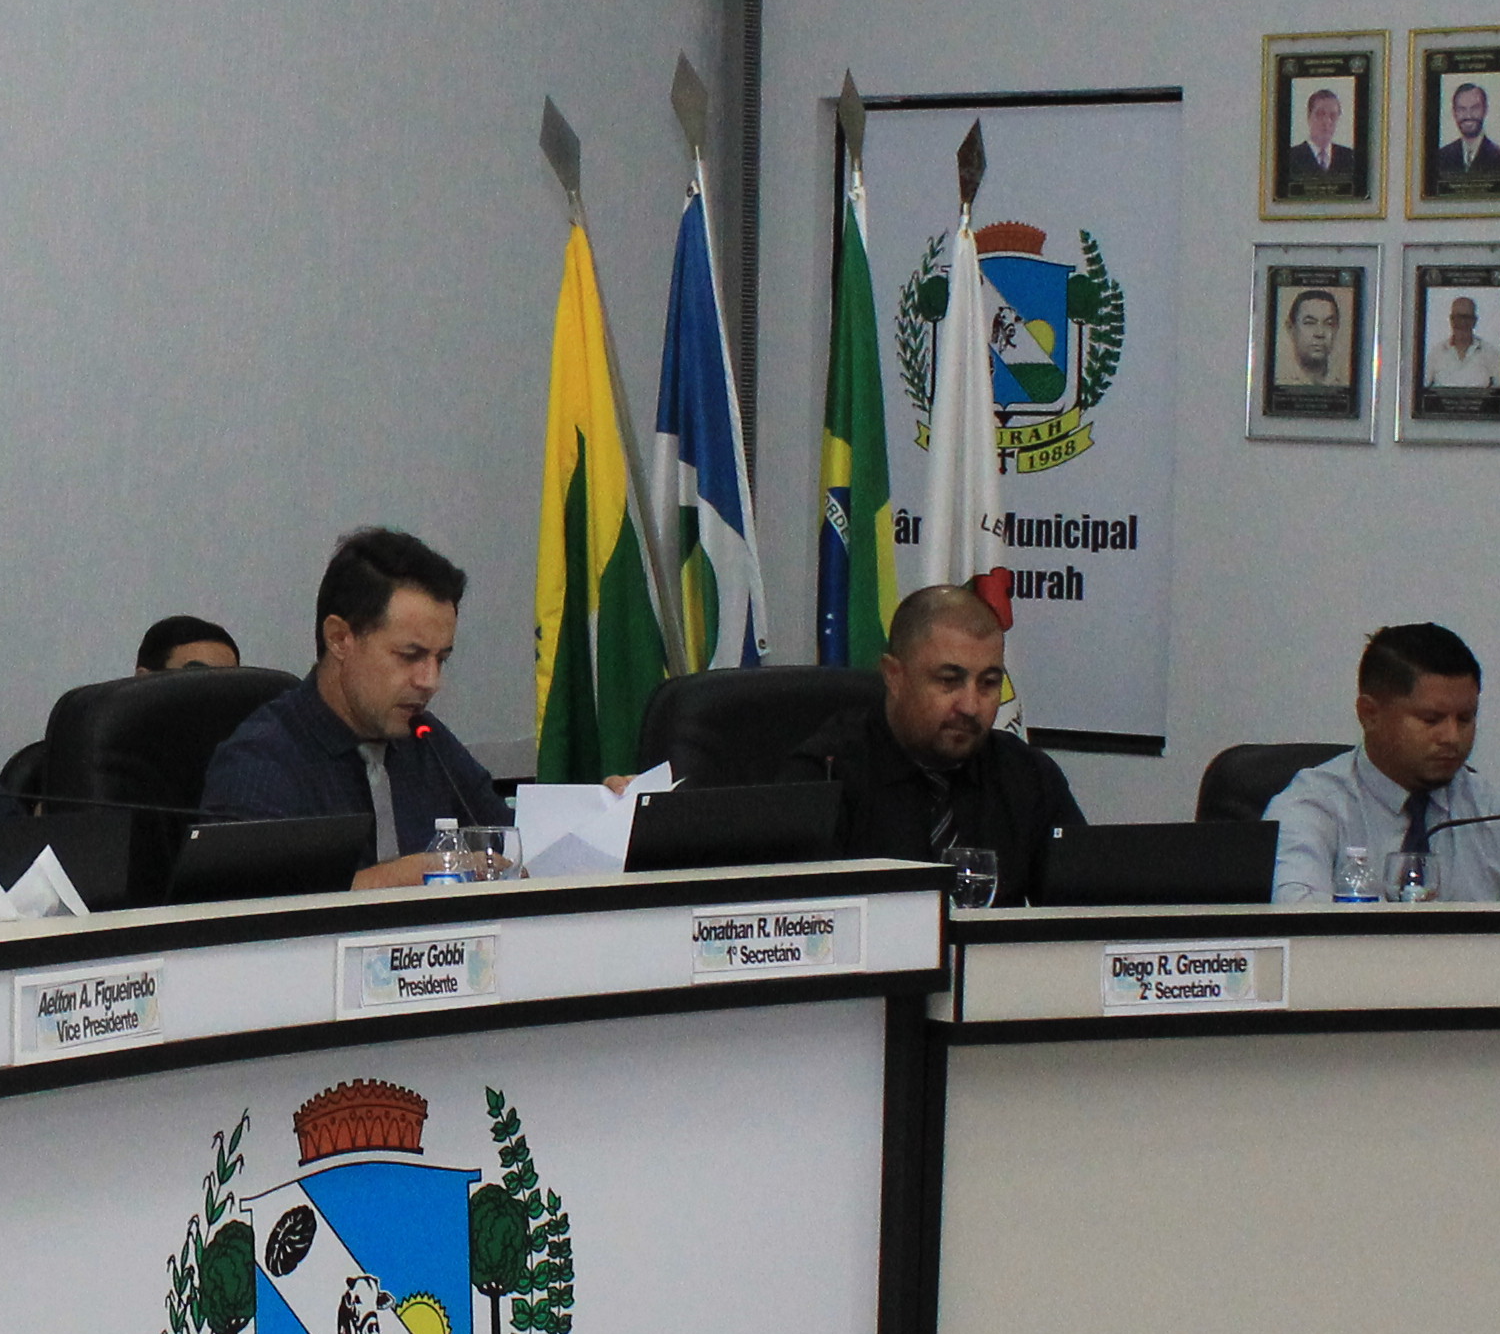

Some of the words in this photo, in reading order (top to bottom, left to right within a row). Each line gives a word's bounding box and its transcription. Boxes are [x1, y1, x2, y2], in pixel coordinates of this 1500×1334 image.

[1028, 439, 1077, 469] 1988
[692, 919, 754, 943] Jonathan
[757, 917, 770, 939] R.
[774, 916, 835, 938] Medeiros
[390, 947, 424, 972] Elder
[427, 941, 465, 968] Gobbi
[740, 942, 802, 966] Secretário
[1112, 956, 1154, 982] Diego
[1158, 955, 1172, 976] R.
[1177, 953, 1248, 974] Grendene
[79, 983, 91, 1009] A.
[95, 972, 156, 1011] Figueiredo
[398, 972, 459, 998] Presidente
[1155, 979, 1221, 999] Secretário
[56, 1019, 80, 1043] Vice
[83, 1010, 140, 1039] Presidente
